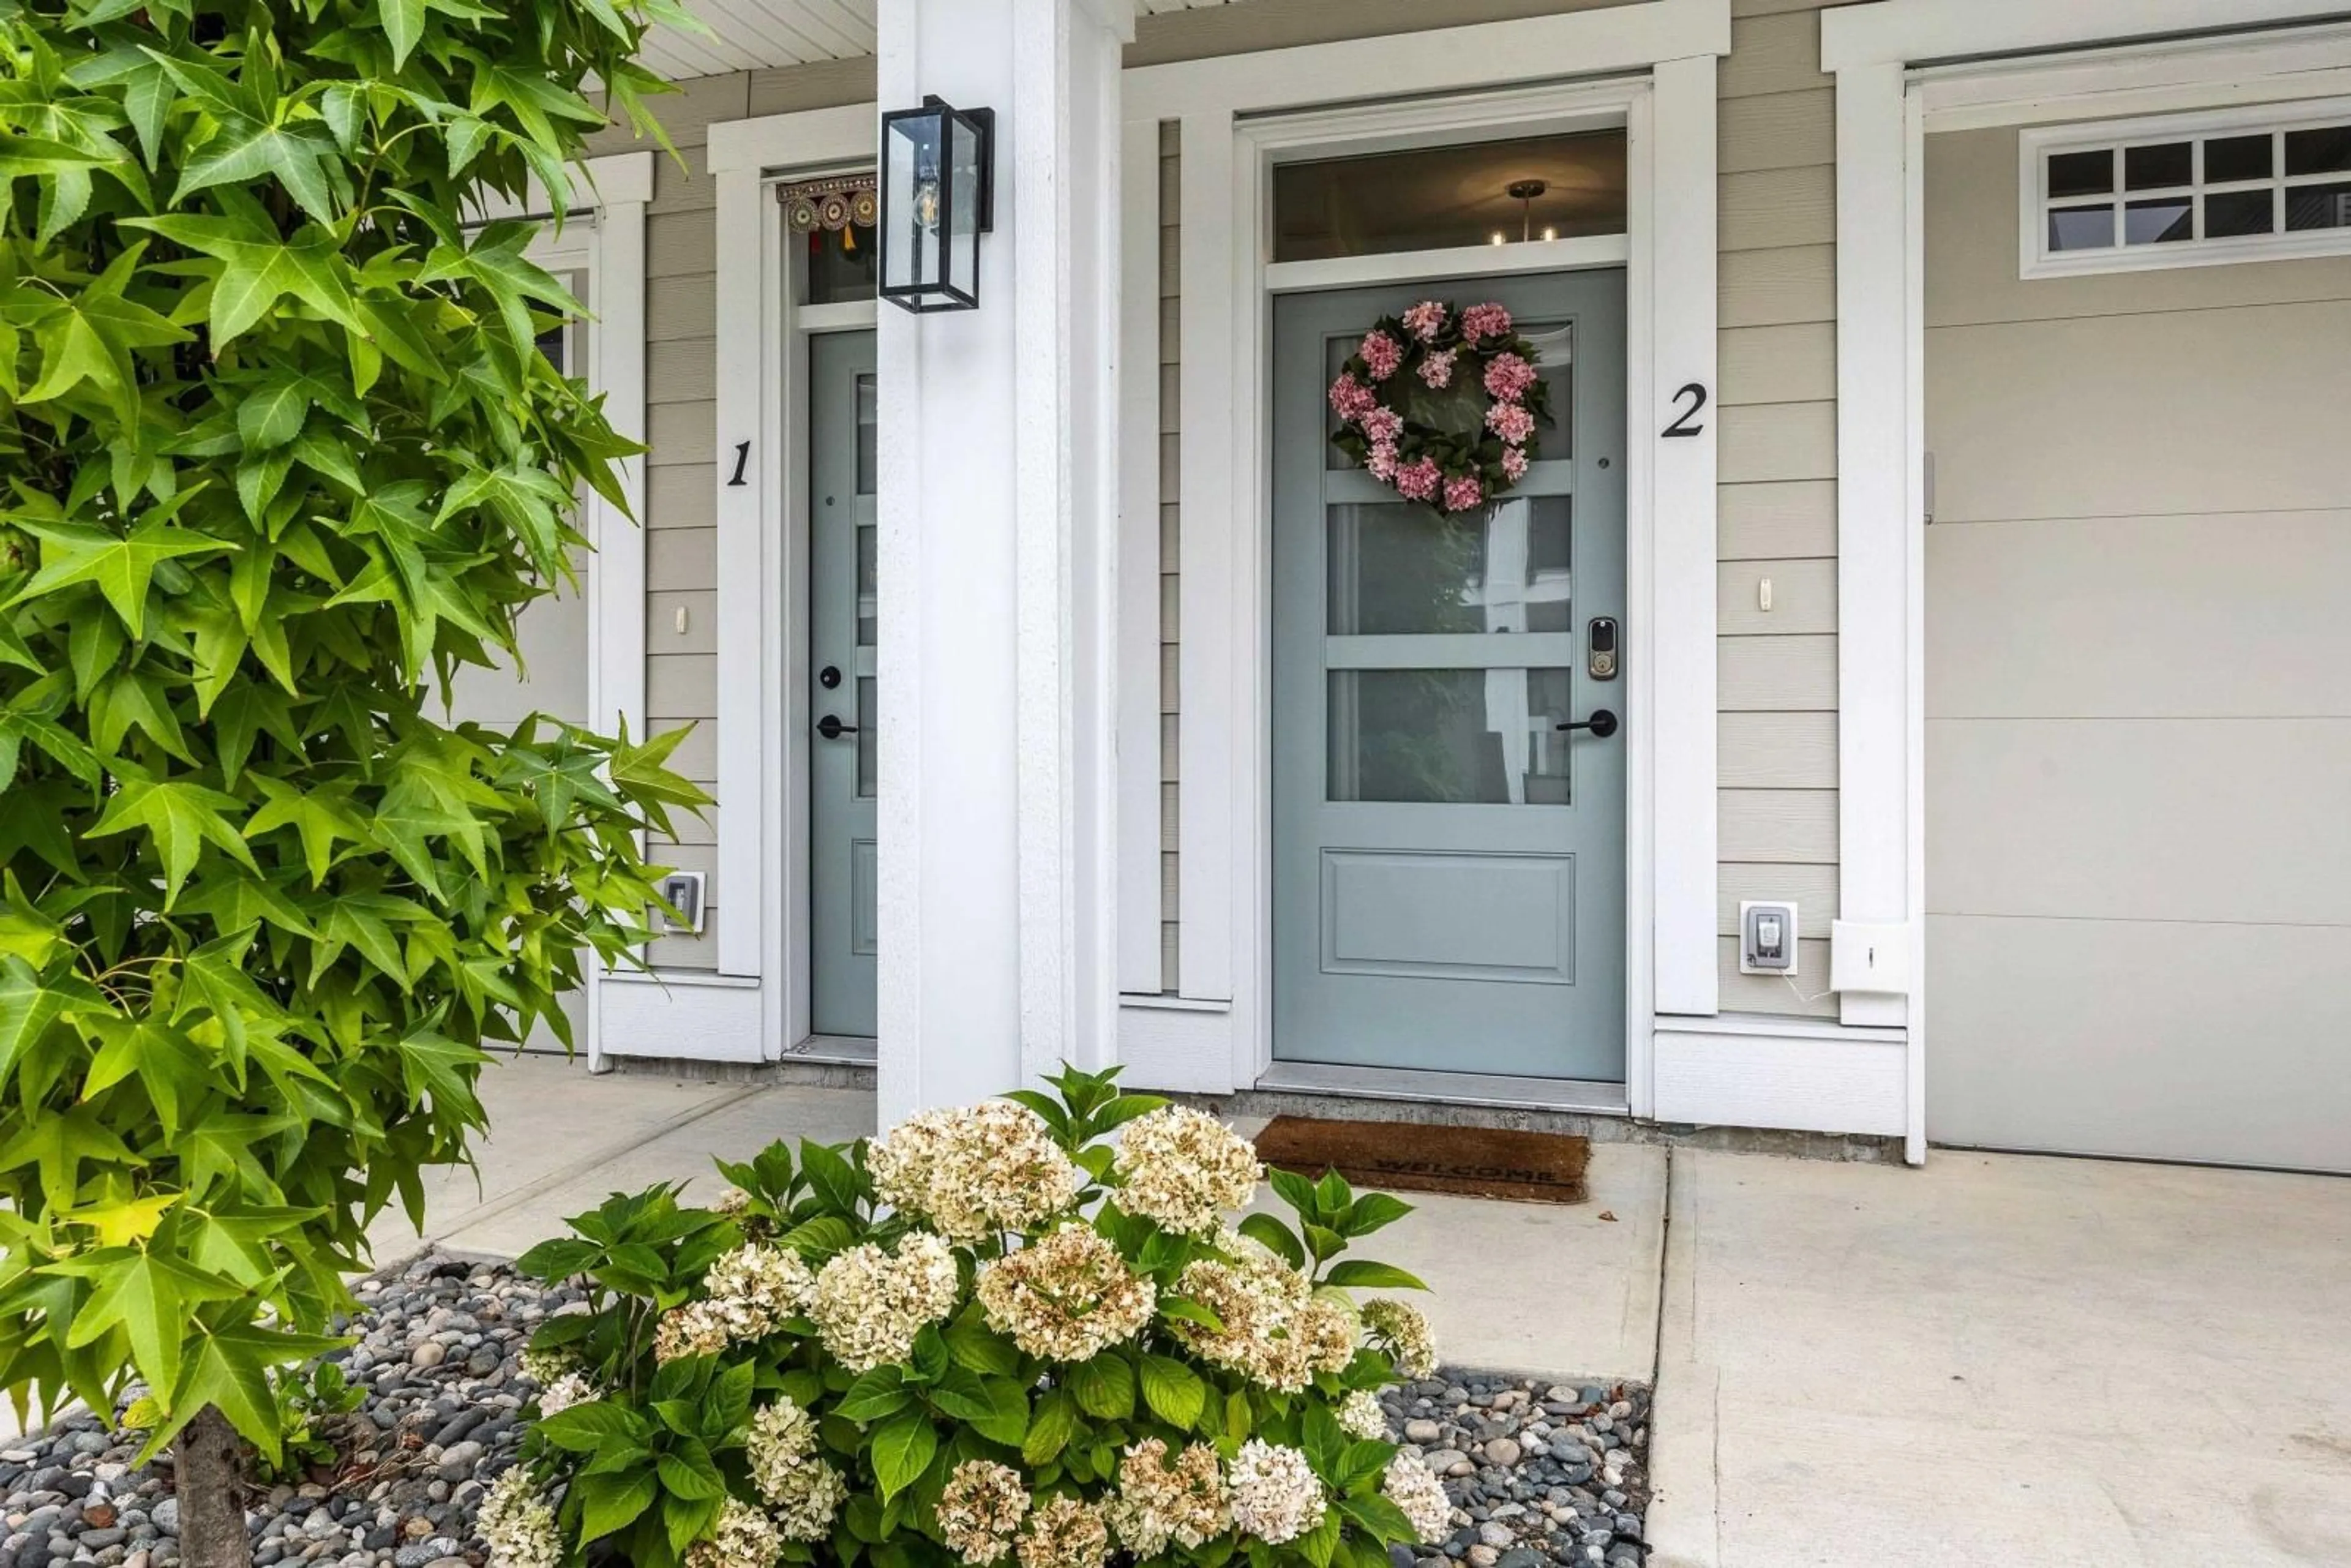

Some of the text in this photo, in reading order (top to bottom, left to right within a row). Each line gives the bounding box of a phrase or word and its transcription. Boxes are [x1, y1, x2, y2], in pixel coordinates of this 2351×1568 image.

[1660, 382, 1707, 438] 2
[727, 440, 751, 486] 1
[1374, 1159, 1557, 1182] WELCOME
